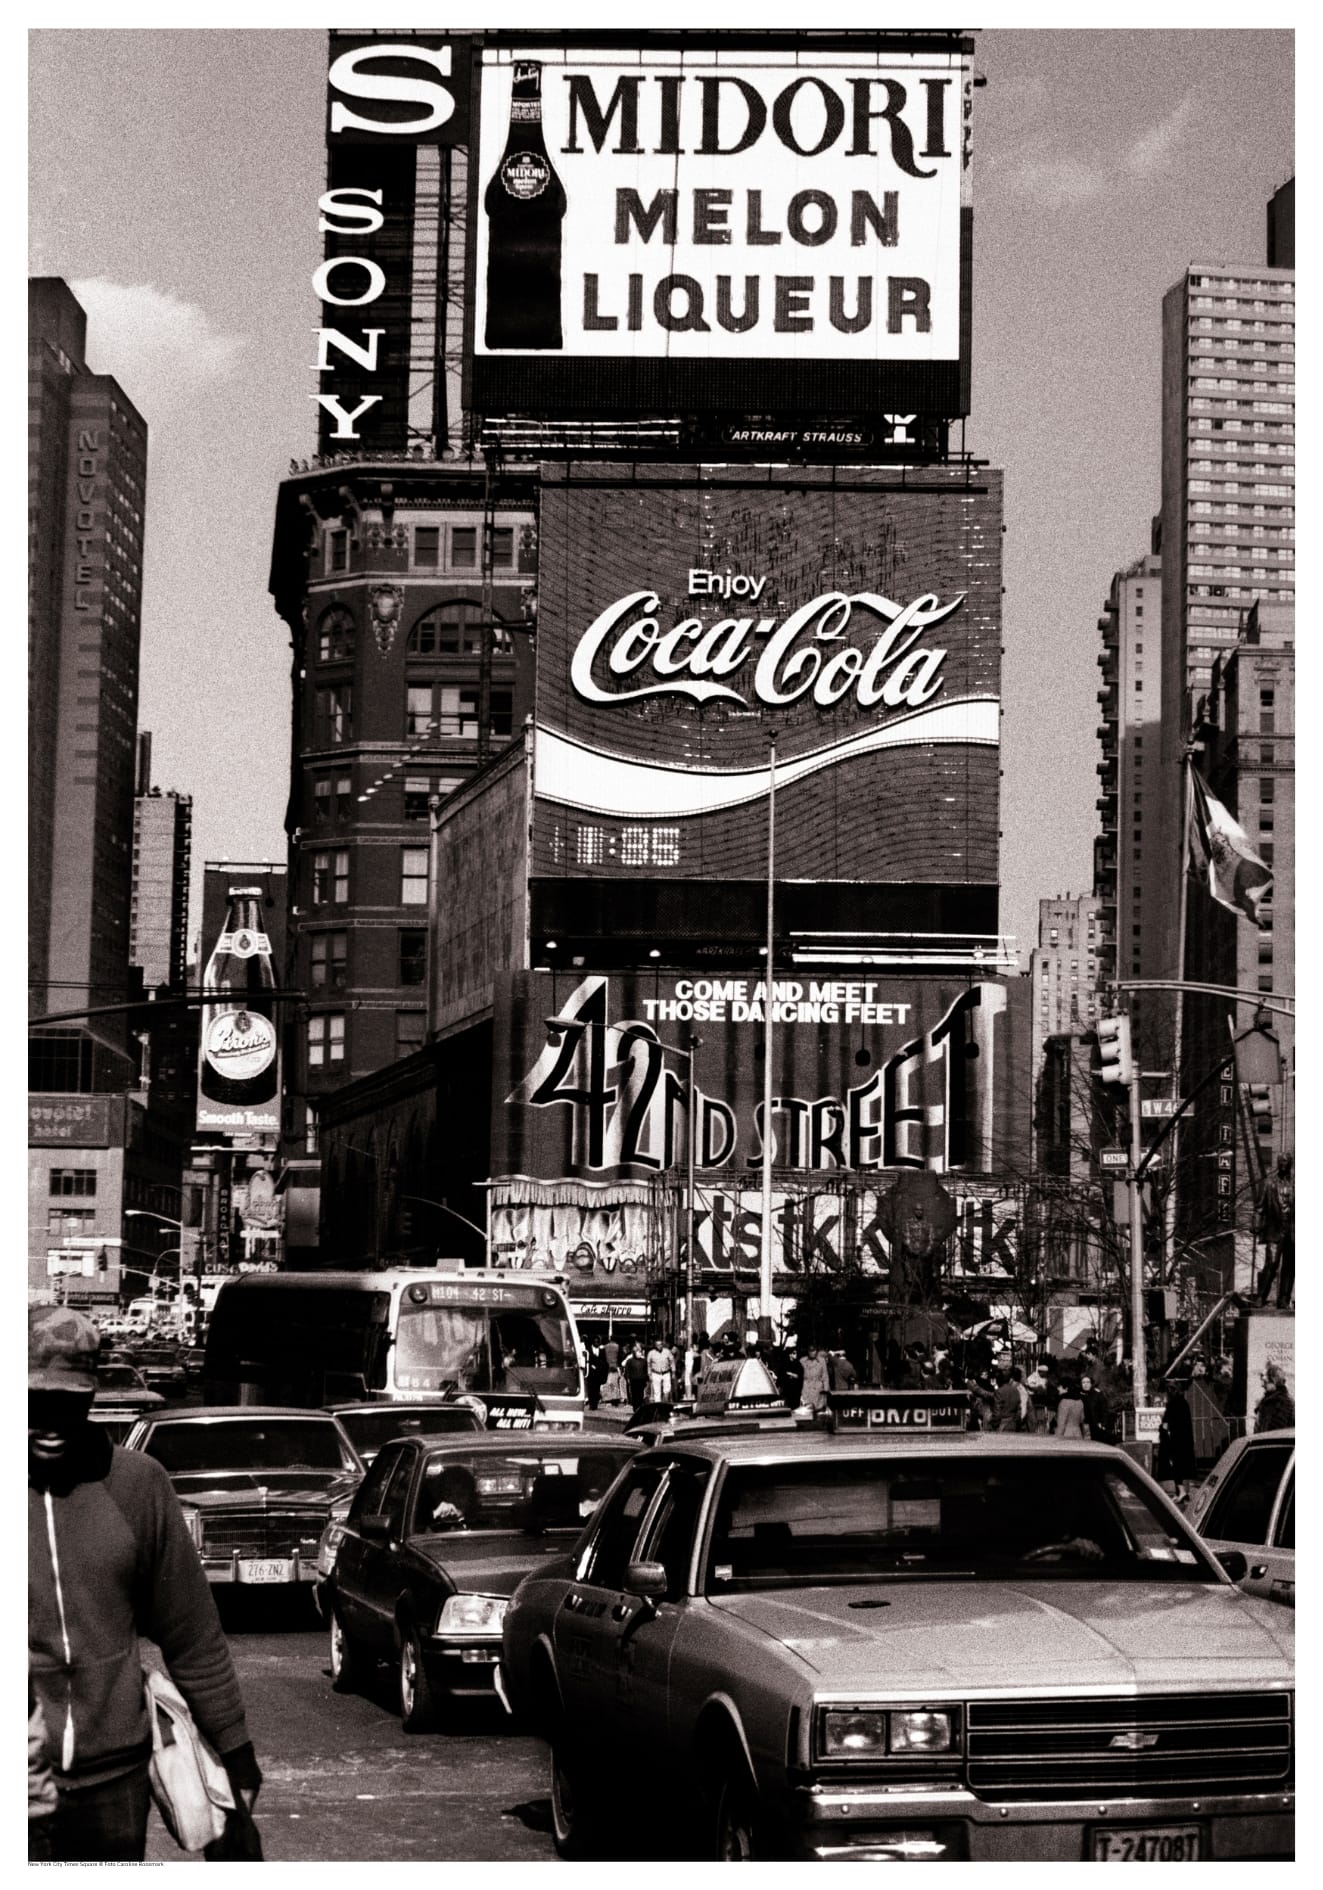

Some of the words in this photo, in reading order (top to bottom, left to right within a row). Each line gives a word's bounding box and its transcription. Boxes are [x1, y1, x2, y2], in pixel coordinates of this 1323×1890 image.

[328, 44, 456, 134] S
[560, 74, 953, 178] MIDORI
[614, 187, 900, 247] MELON
[308, 187, 386, 439] SONY
[582, 272, 933, 334] LIQUEUR
[731, 431, 798, 441] ARTKRAFT
[802, 432, 863, 443] STRAUSS
[75, 430, 98, 610] NOVOTEL
[688, 569, 767, 598] Enjoy
[571, 590, 969, 707] Coca-Cola
[675, 981, 748, 1000] COME
[753, 982, 803, 1001] AND
[808, 982, 878, 1003] MEET
[643, 1000, 726, 1022] THOSE
[731, 1002, 839, 1023] DANCING
[845, 1004, 911, 1024] FEET
[505, 976, 738, 1170] 42ND
[746, 982, 1007, 1172] STREET
[199, 1110, 244, 1125] Smooth
[1152, 1102, 1163, 1114] W
[1106, 1155, 1126, 1163] ONE
[471, 1288, 486, 1301] 42
[489, 1407, 505, 1417] ALL
[496, 1418, 511, 1429] ALL
